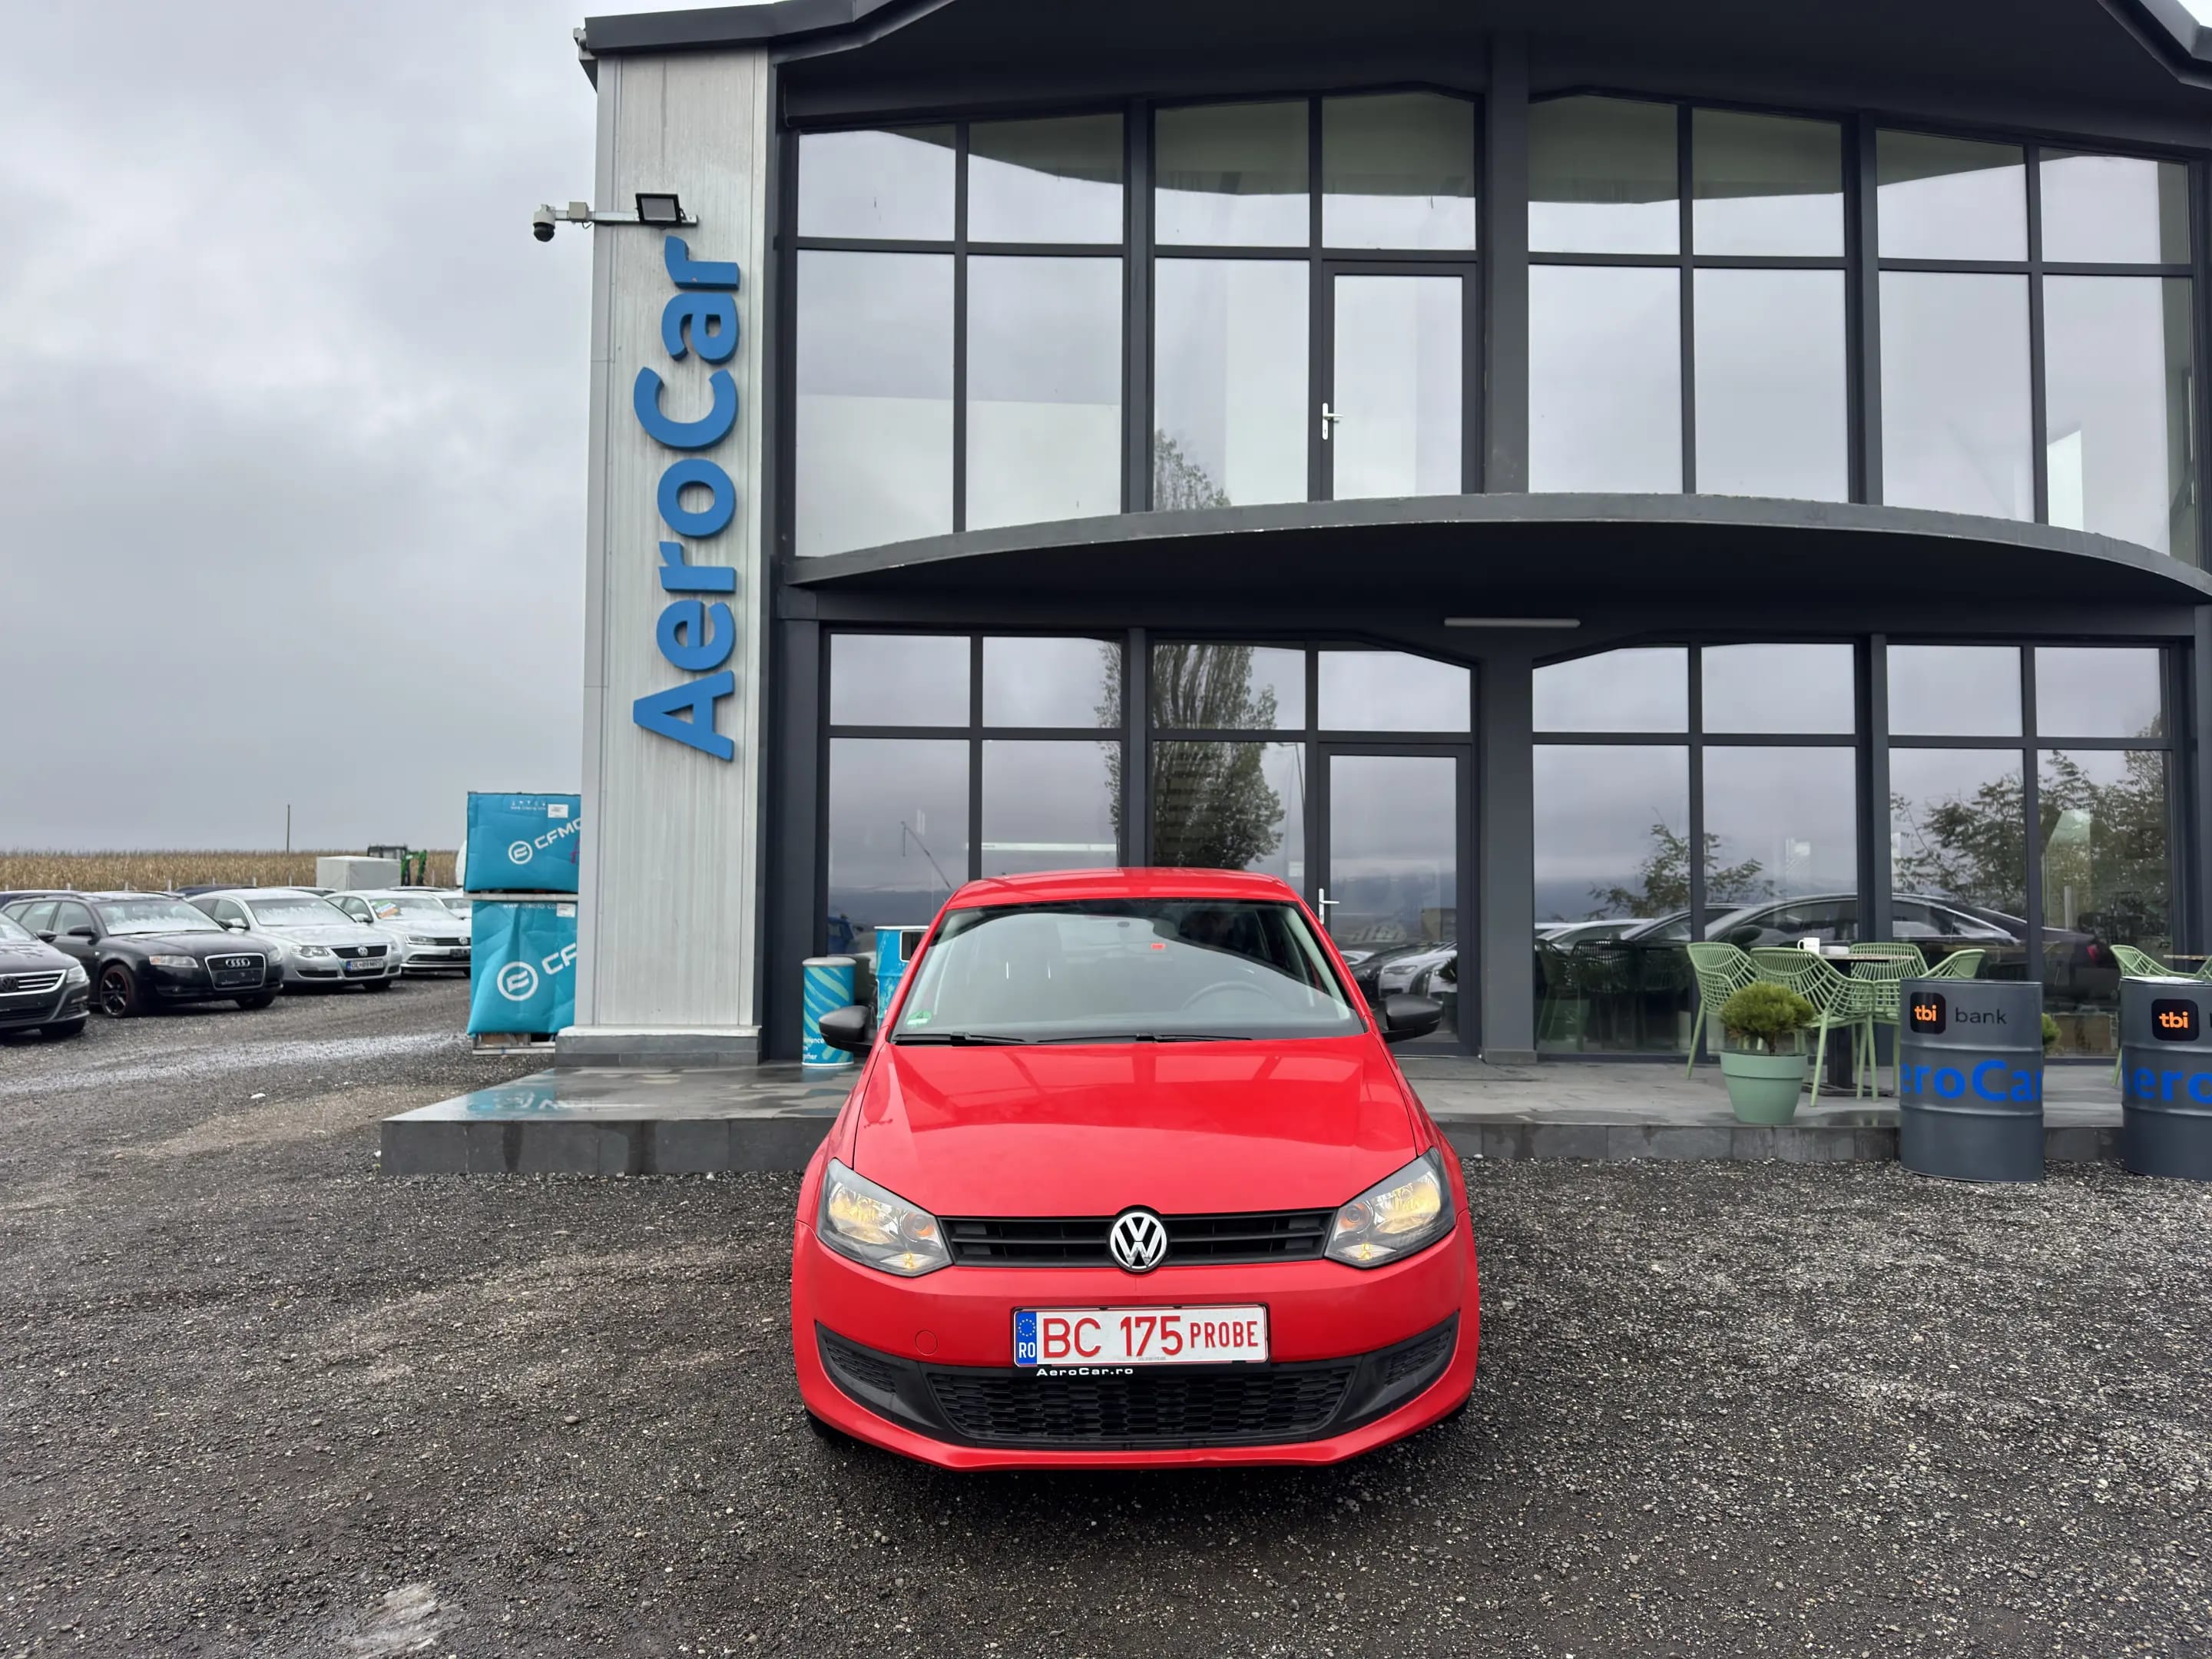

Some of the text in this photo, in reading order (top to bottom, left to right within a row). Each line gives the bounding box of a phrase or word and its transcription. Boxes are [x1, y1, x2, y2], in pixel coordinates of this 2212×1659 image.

[632, 235, 740, 762] AeroCar
[1914, 1005, 2007, 1025] tbi bank
[2159, 1012, 2188, 1028] tbi
[1018, 1316, 1259, 1359] RO BC 175 PROBE
[1036, 1367, 1134, 1376] AeroCar.ro
